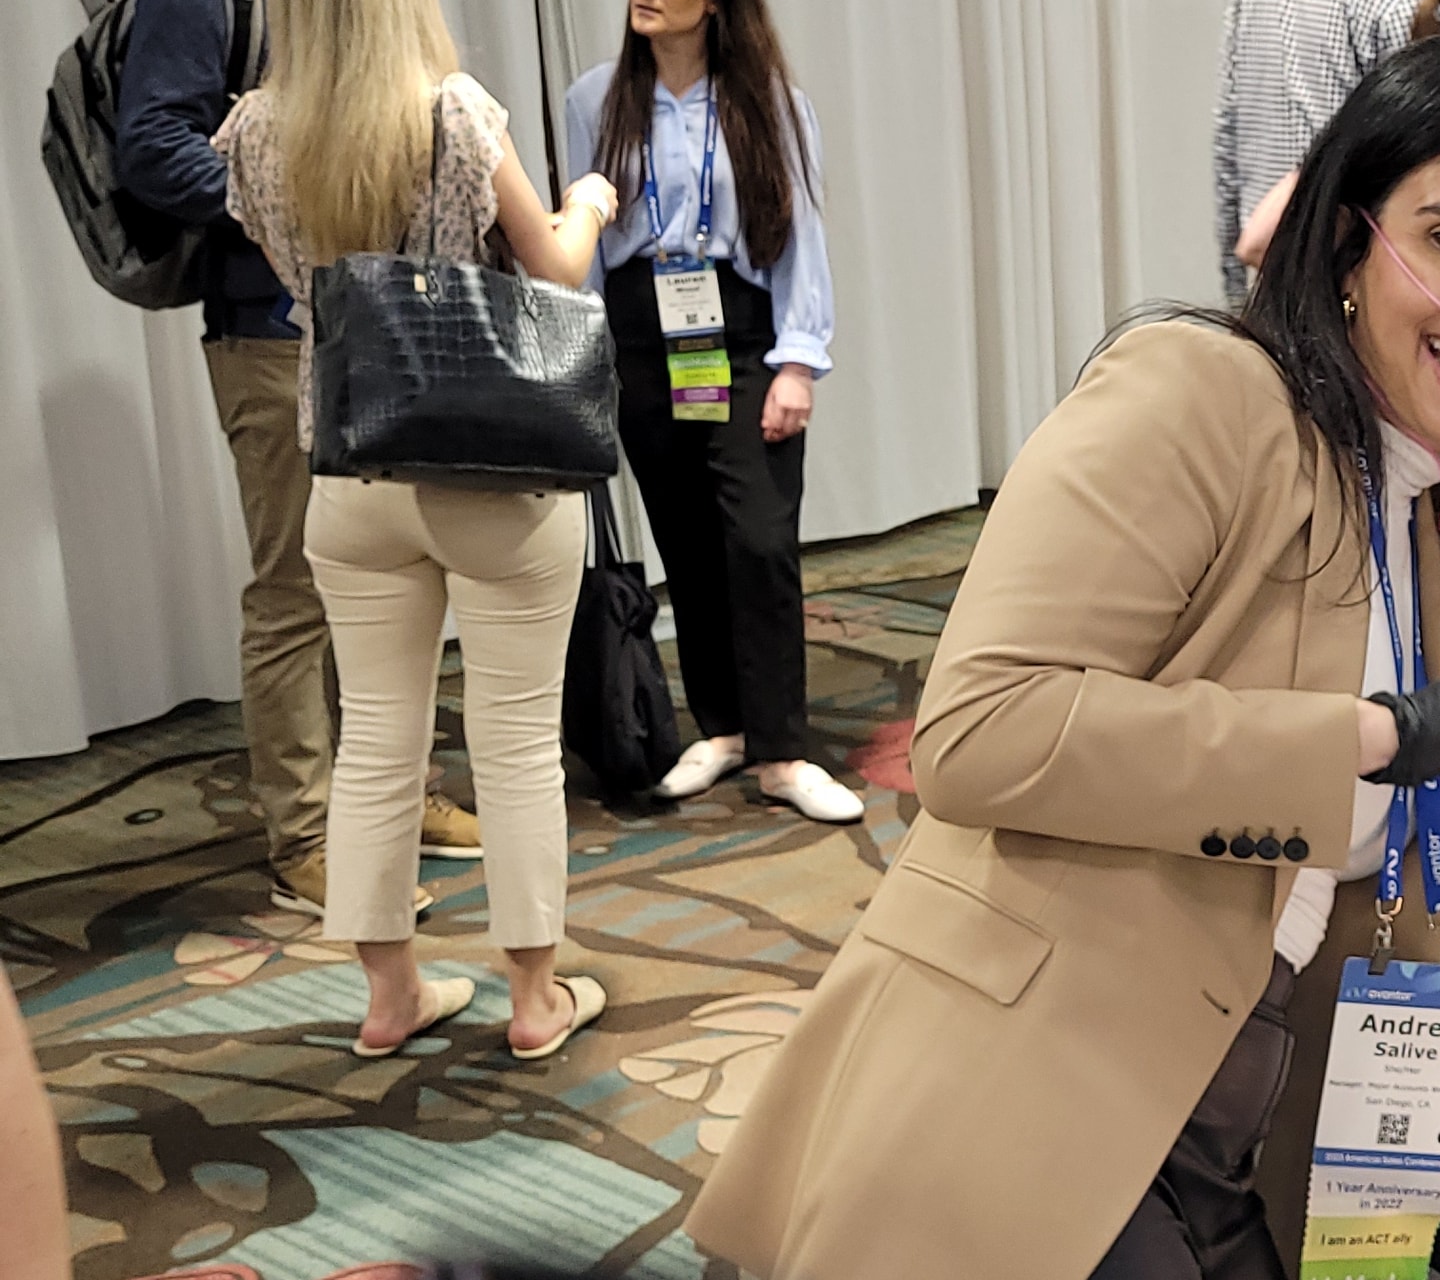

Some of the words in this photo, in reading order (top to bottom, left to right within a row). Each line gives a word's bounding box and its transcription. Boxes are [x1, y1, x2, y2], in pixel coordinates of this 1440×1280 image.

[1374, 1041, 1438, 1060] Salive
[1337, 1181, 1364, 1193] Year
[1327, 1236, 1346, 1245] am
[1348, 1235, 1363, 1245] an
[1365, 1234, 1390, 1245] ACT
